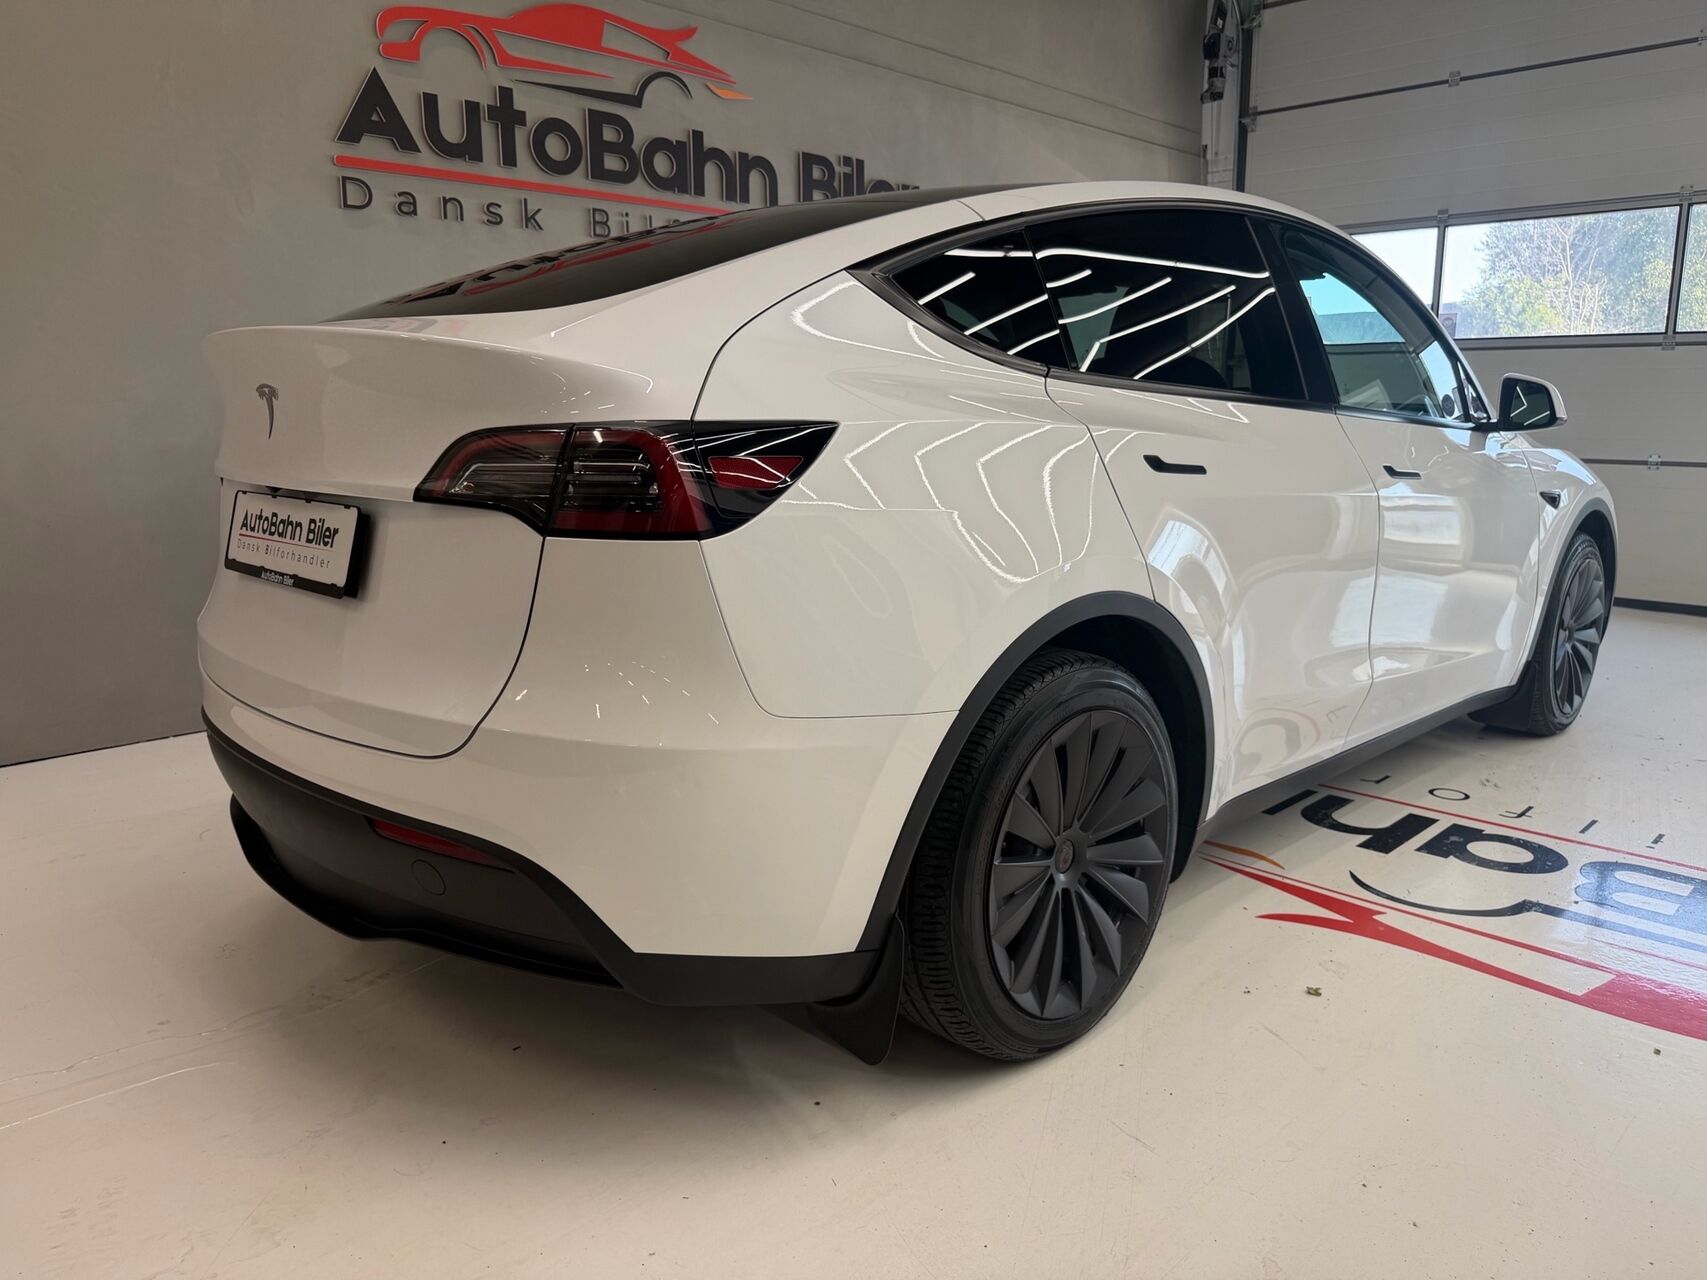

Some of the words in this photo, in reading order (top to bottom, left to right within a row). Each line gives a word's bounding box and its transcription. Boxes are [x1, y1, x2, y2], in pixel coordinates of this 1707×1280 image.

[335, 65, 778, 207] AutoBahn
[798, 150, 920, 202] Bil
[339, 175, 544, 232] Dansk
[240, 508, 304, 543] AutoBahn
[305, 517, 340, 549] Biler
[237, 538, 261, 553] Dansk
[264, 543, 331, 569] Bilforhandler
